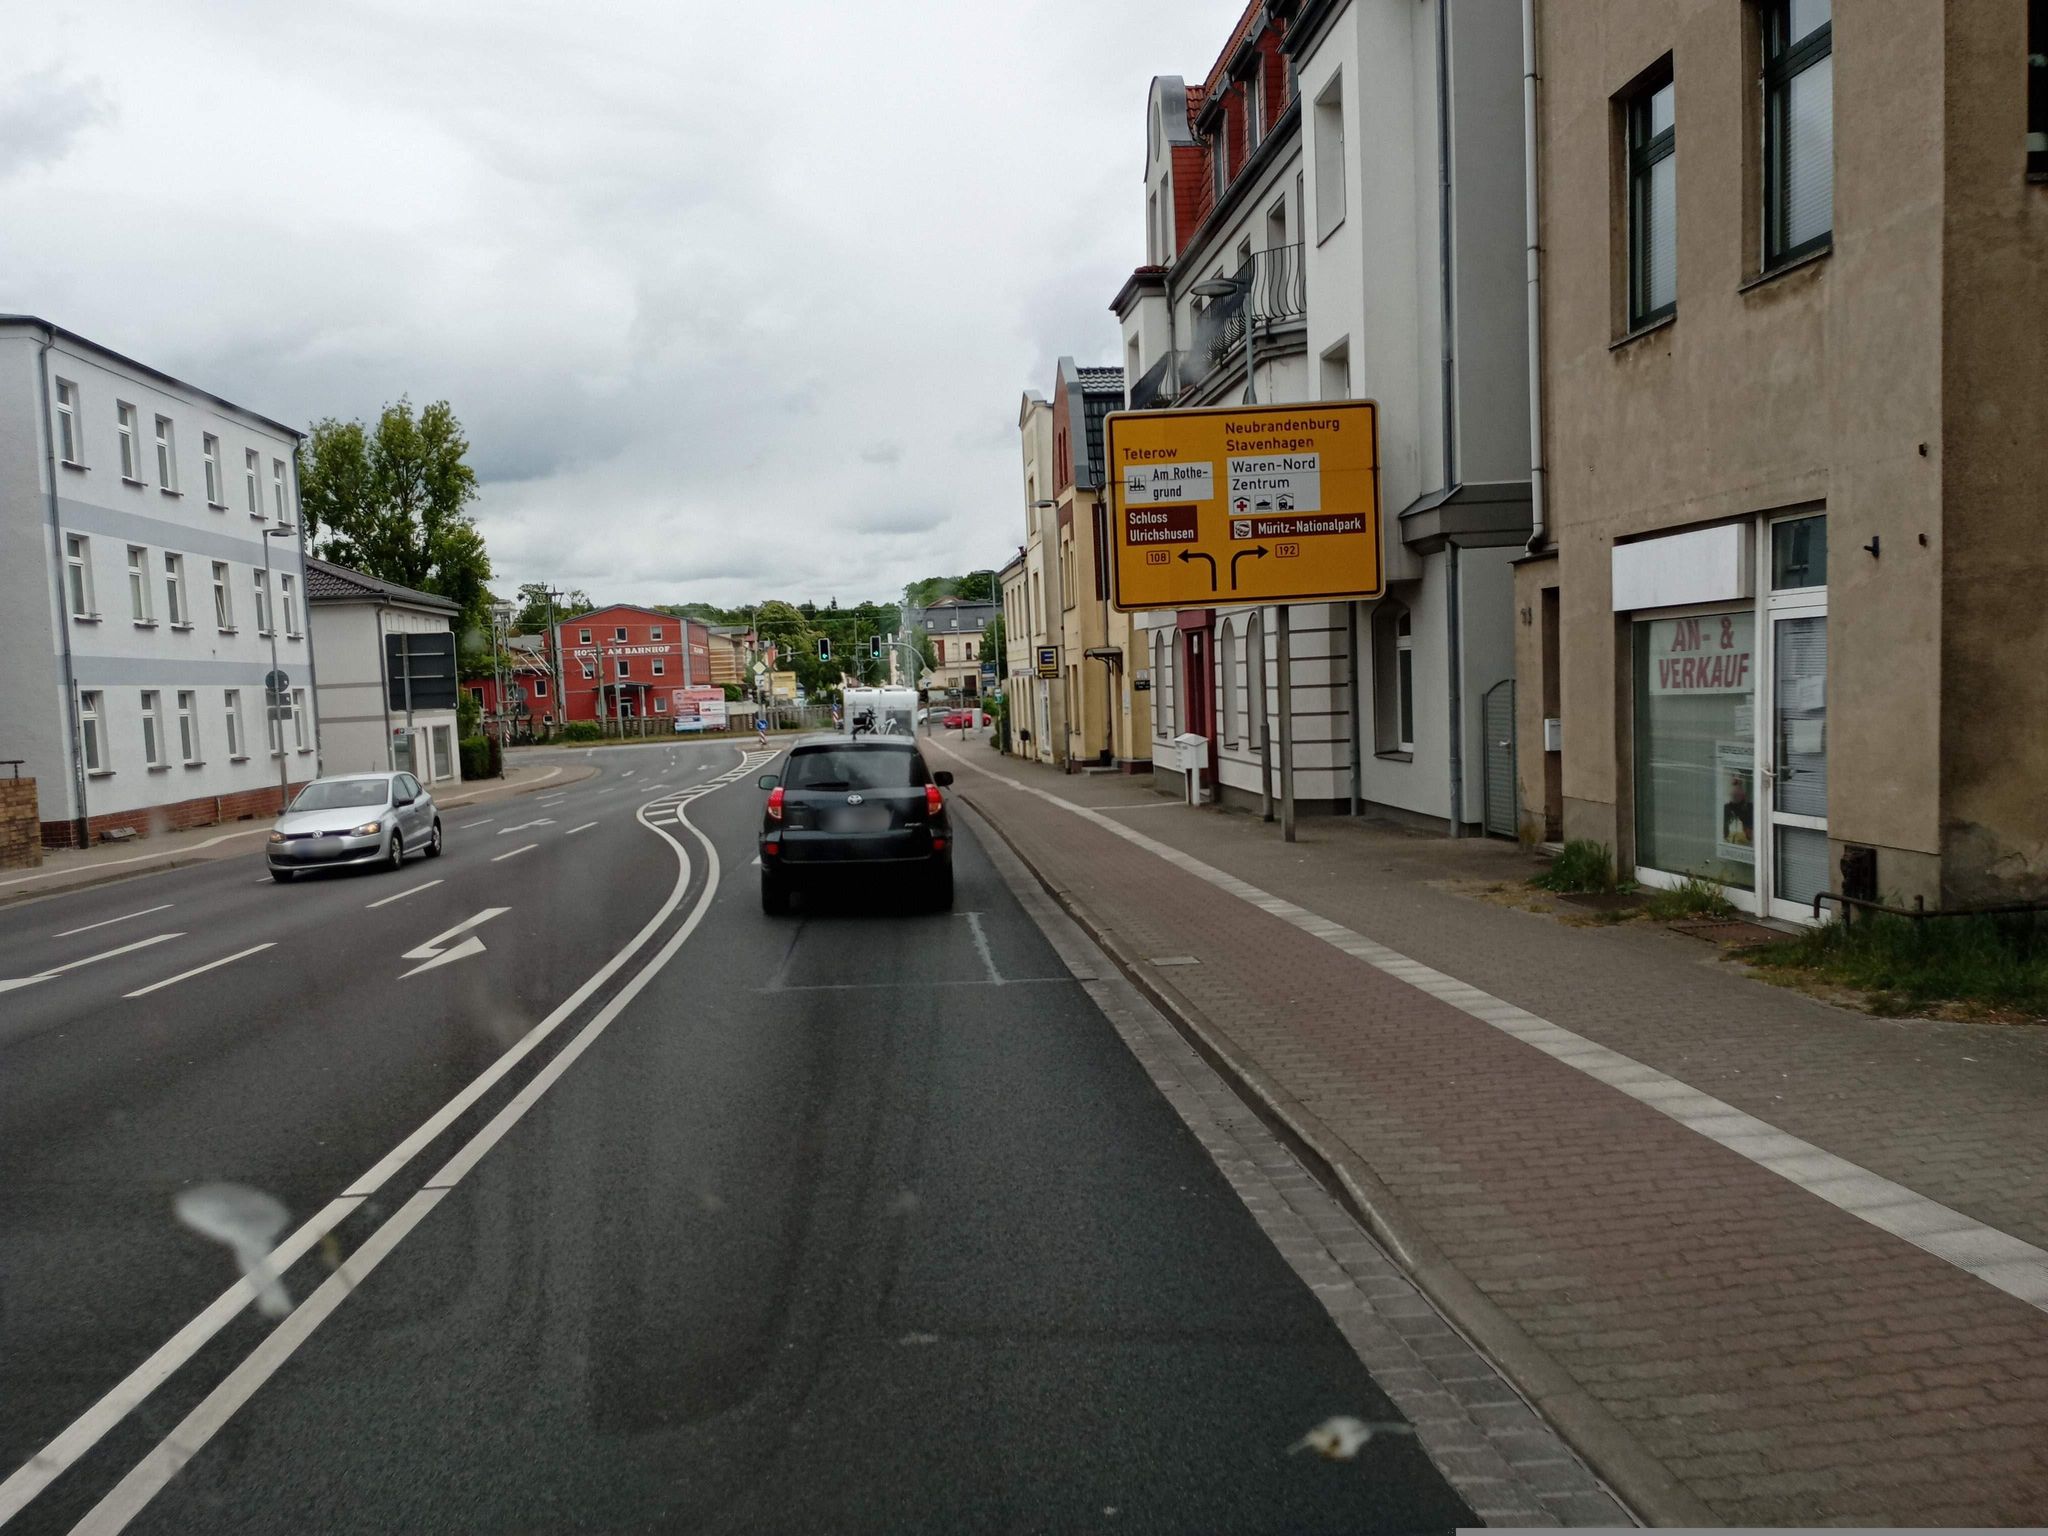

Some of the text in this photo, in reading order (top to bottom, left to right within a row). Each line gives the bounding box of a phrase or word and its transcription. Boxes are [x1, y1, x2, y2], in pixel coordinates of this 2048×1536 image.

[1225, 418, 1340, 434] Neubrandenburg
[1226, 436, 1314, 452] Stavenhagen
[1123, 447, 1178, 460] Teterow
[1232, 457, 1316, 473] Waren-Nord
[1153, 467, 1208, 481] Am Rothe-
[1232, 477, 1290, 491] Zentrum
[1153, 485, 1182, 500] grund
[1129, 512, 1168, 525] Schloss
[1257, 518, 1362, 535] Müritz-Nationalpark
[1130, 527, 1194, 541] Ulrichshusen
[1150, 553, 1167, 562] 108
[1279, 546, 1296, 556] 192
[1671, 616, 1735, 652] AN- &
[625, 646, 670, 655] BAHNHOF
[1658, 653, 1750, 688] VERKAUF
